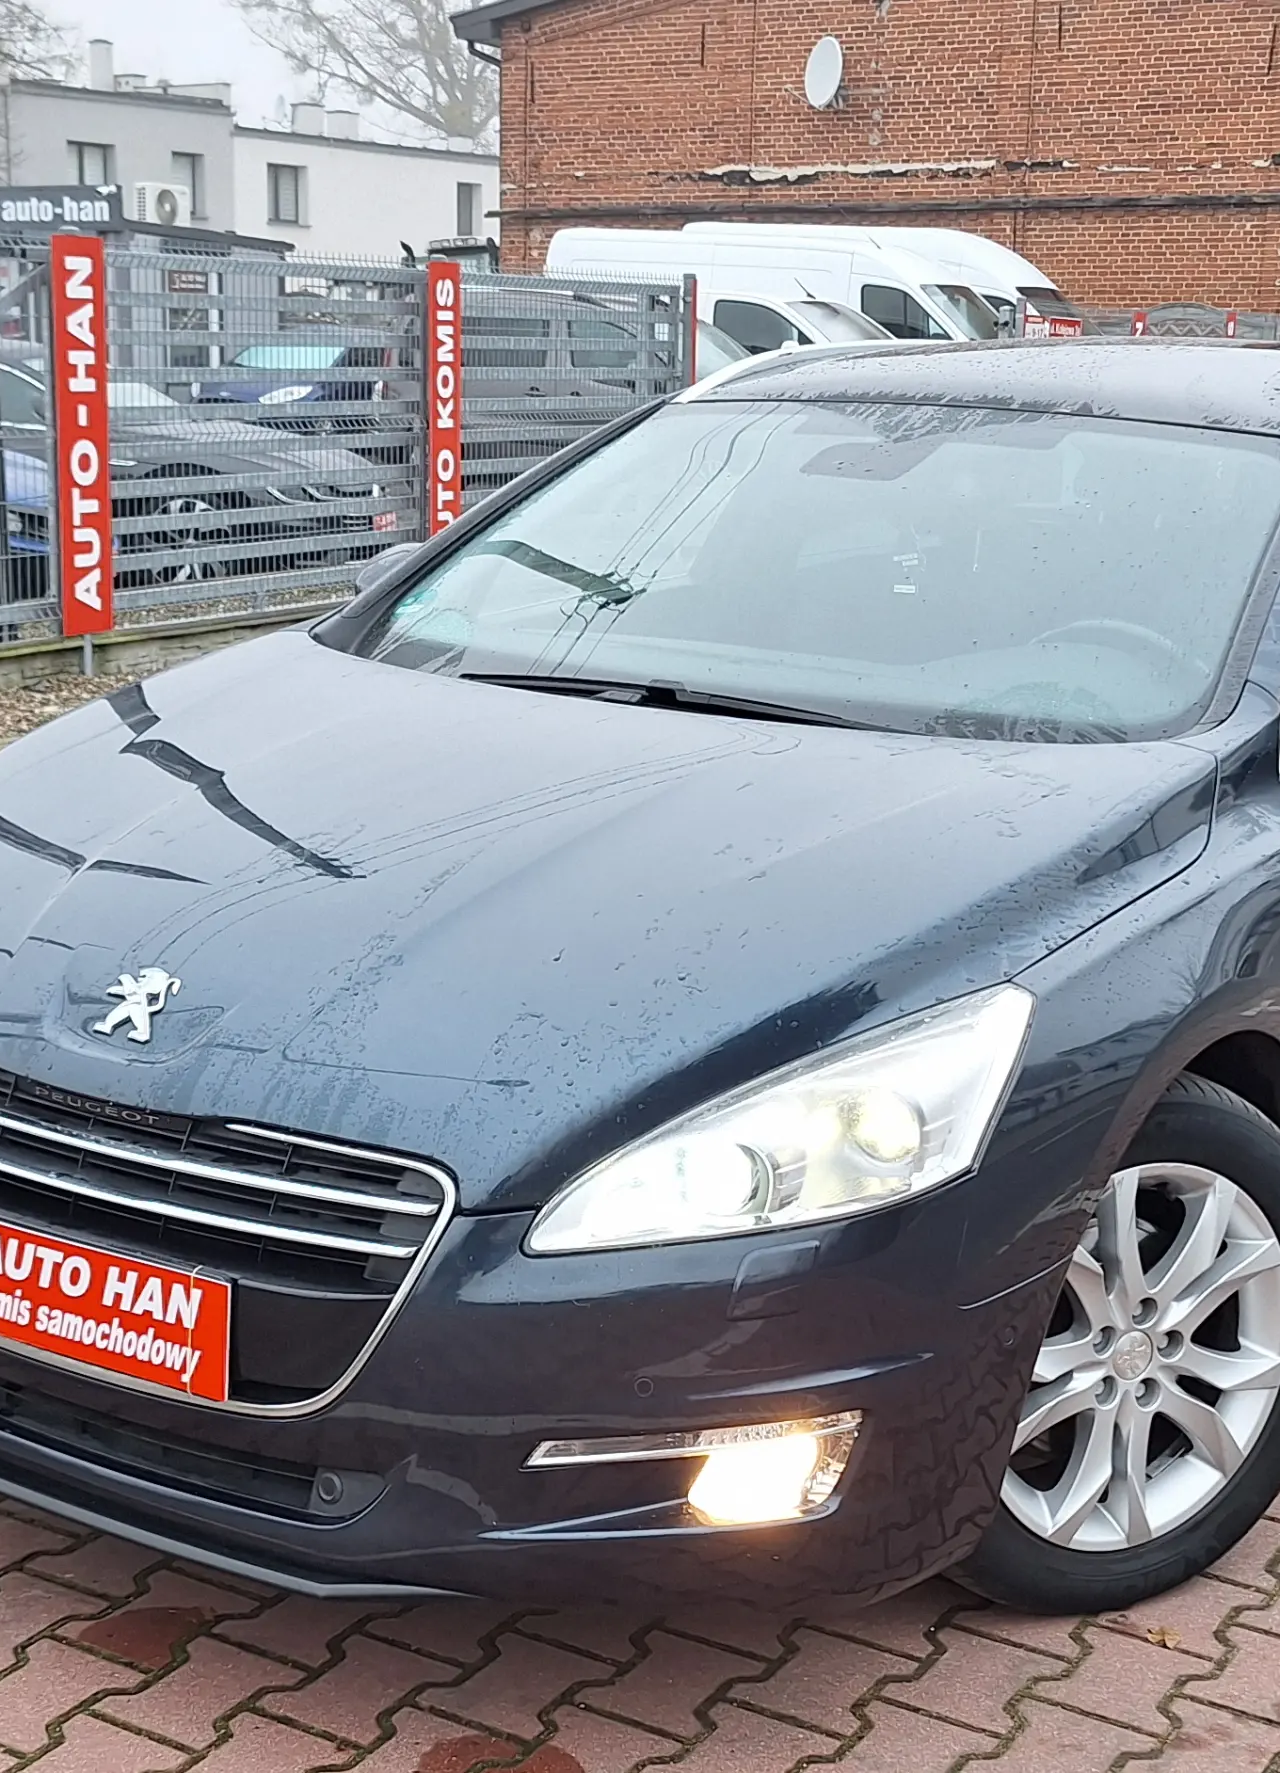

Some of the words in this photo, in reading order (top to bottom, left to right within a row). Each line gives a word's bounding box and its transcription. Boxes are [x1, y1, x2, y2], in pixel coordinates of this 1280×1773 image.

[1, 196, 110, 223] auto-han
[436, 279, 455, 428] KOMIS
[35, 1086, 160, 1125] PEUGEOT
[101, 1265, 203, 1329] HAN
[34, 1304, 202, 1383] samochodowy
